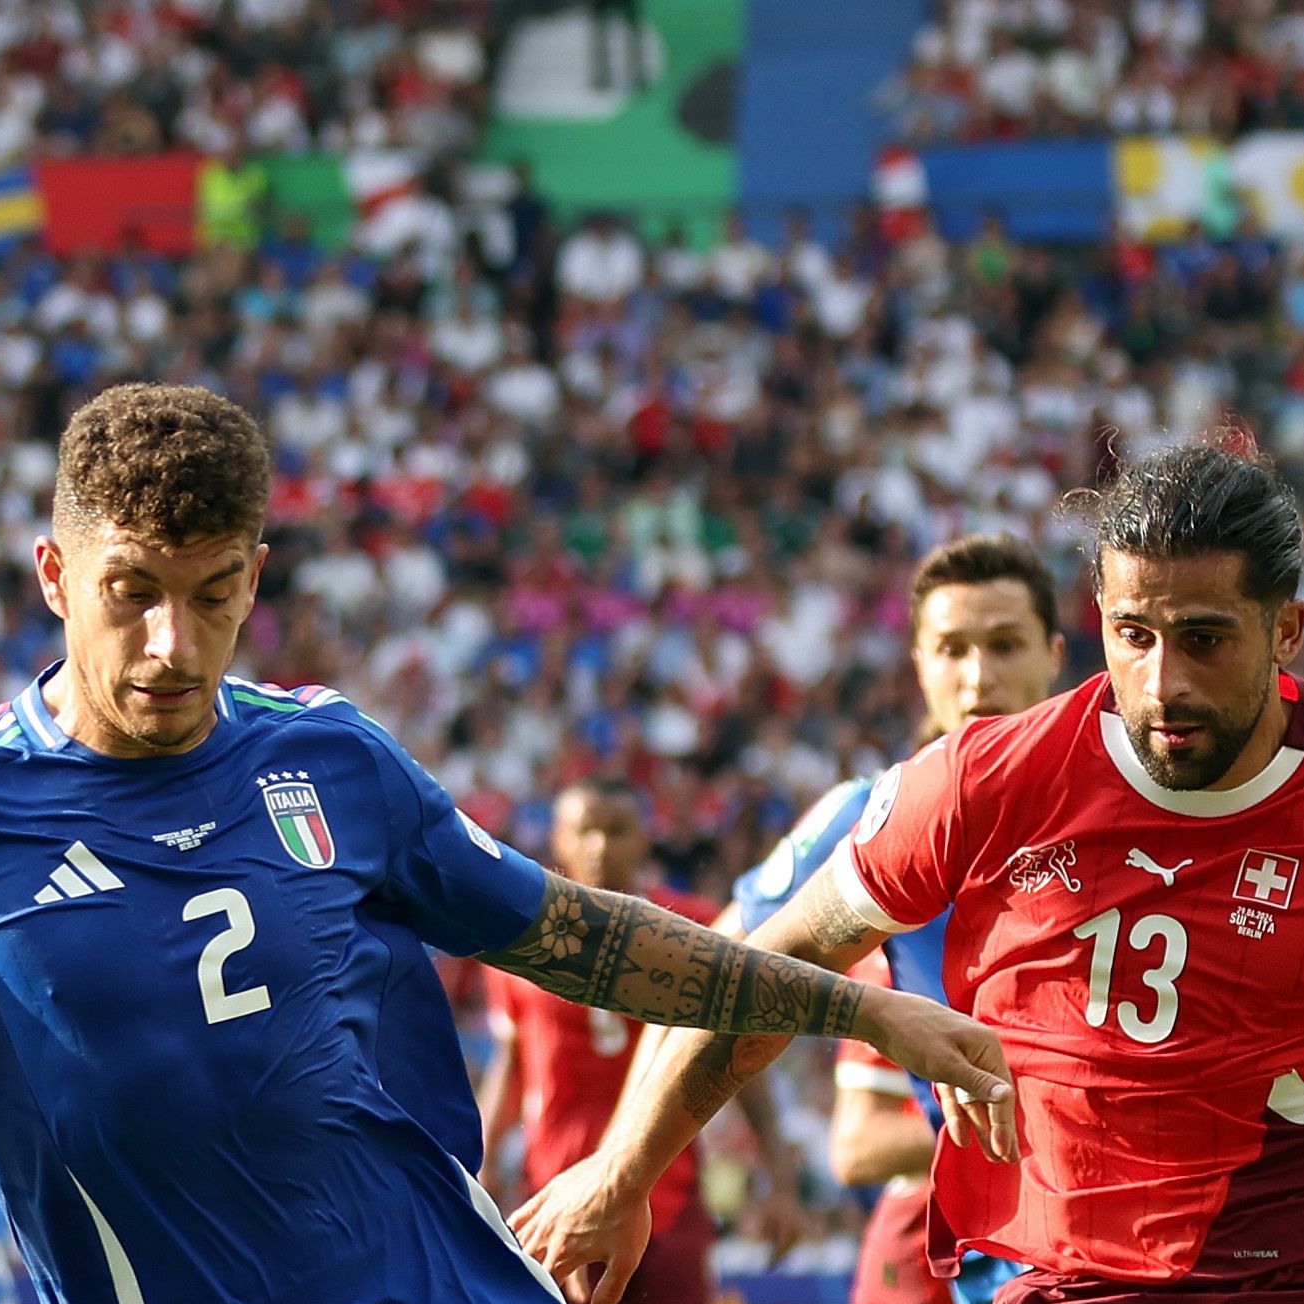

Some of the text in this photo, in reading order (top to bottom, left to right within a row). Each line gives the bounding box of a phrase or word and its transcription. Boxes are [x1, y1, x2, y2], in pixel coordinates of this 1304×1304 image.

[269, 790, 314, 809] ITALIA
[182, 887, 272, 1025] 2
[1229, 912, 1247, 926] SUI
[1257, 919, 1274, 934] ITA
[1073, 907, 1188, 1044] 13
